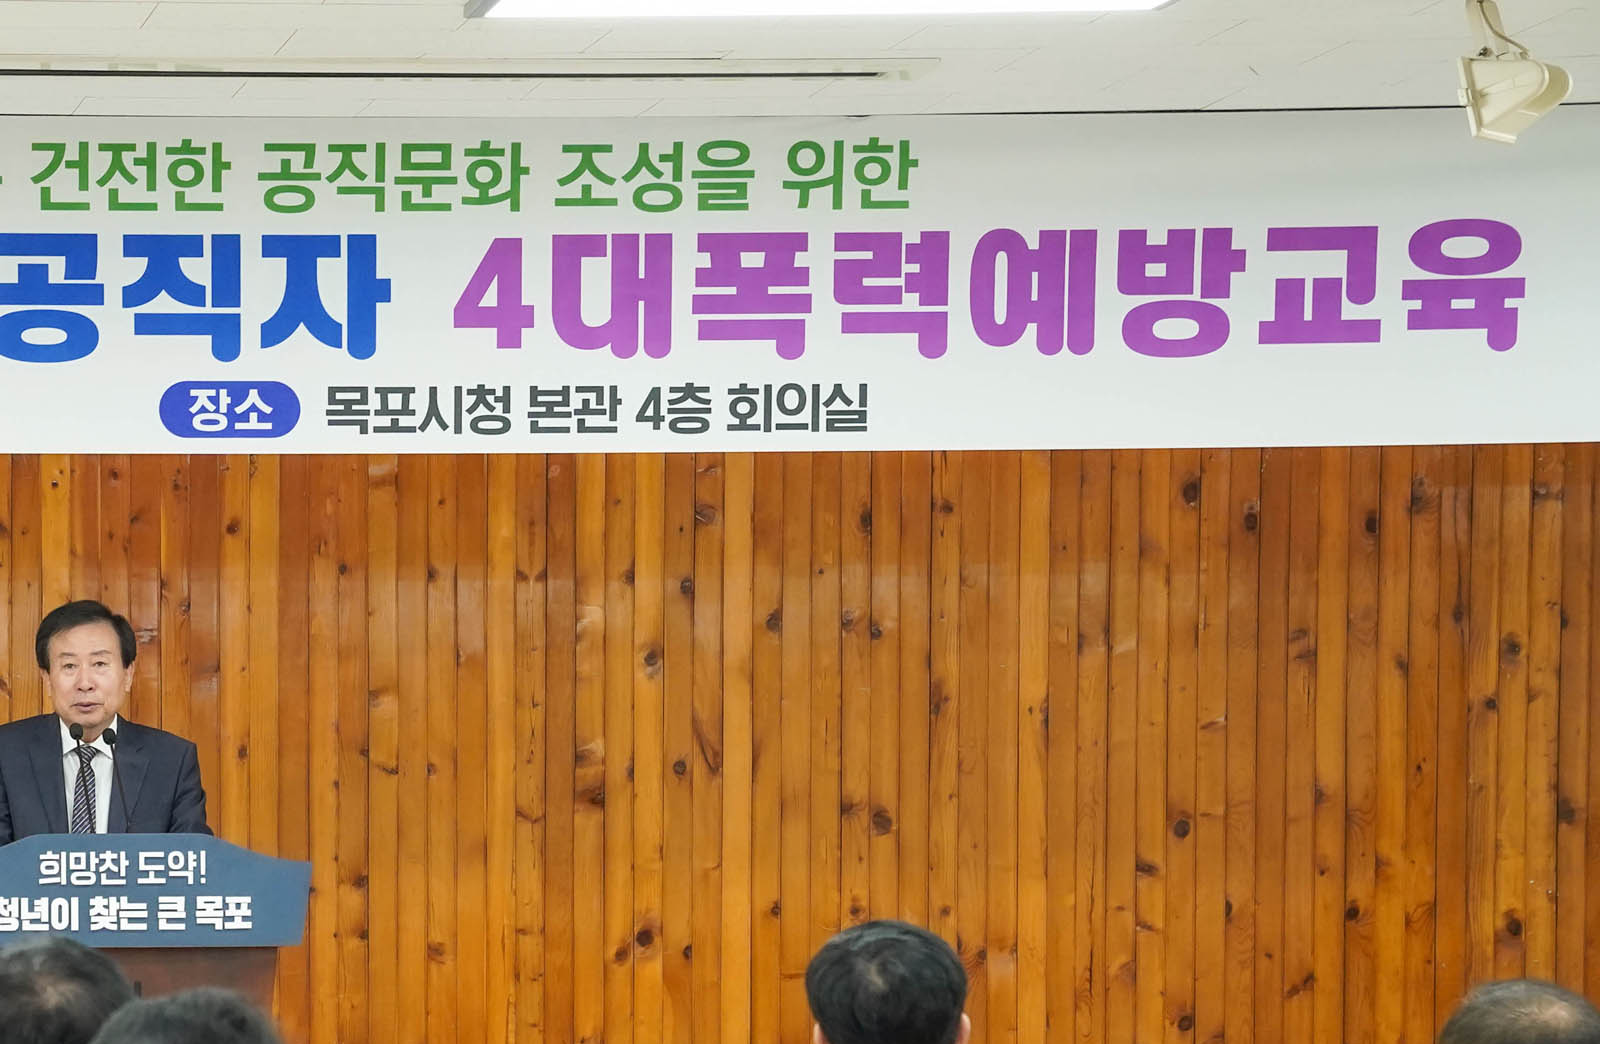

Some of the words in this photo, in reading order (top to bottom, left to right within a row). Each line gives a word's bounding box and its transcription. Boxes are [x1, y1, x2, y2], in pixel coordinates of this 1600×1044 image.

[30, 138, 232, 212] 건전한
[256, 140, 531, 214] 공직문화
[555, 140, 755, 213] 조성을
[782, 136, 919, 210] 위한
[453, 218, 1526, 361] 4대폭력예방교육
[188, 388, 273, 432] 장소
[325, 383, 512, 436] 목포시청
[527, 385, 623, 435] 본관
[636, 382, 712, 435] 4층
[726, 382, 868, 433] 회의실
[38, 850, 130, 886] 희망찬
[136, 850, 207, 885] 도약!
[89, 895, 149, 931] 찾는
[157, 895, 187, 931] 큰
[195, 895, 253, 931] 목포
